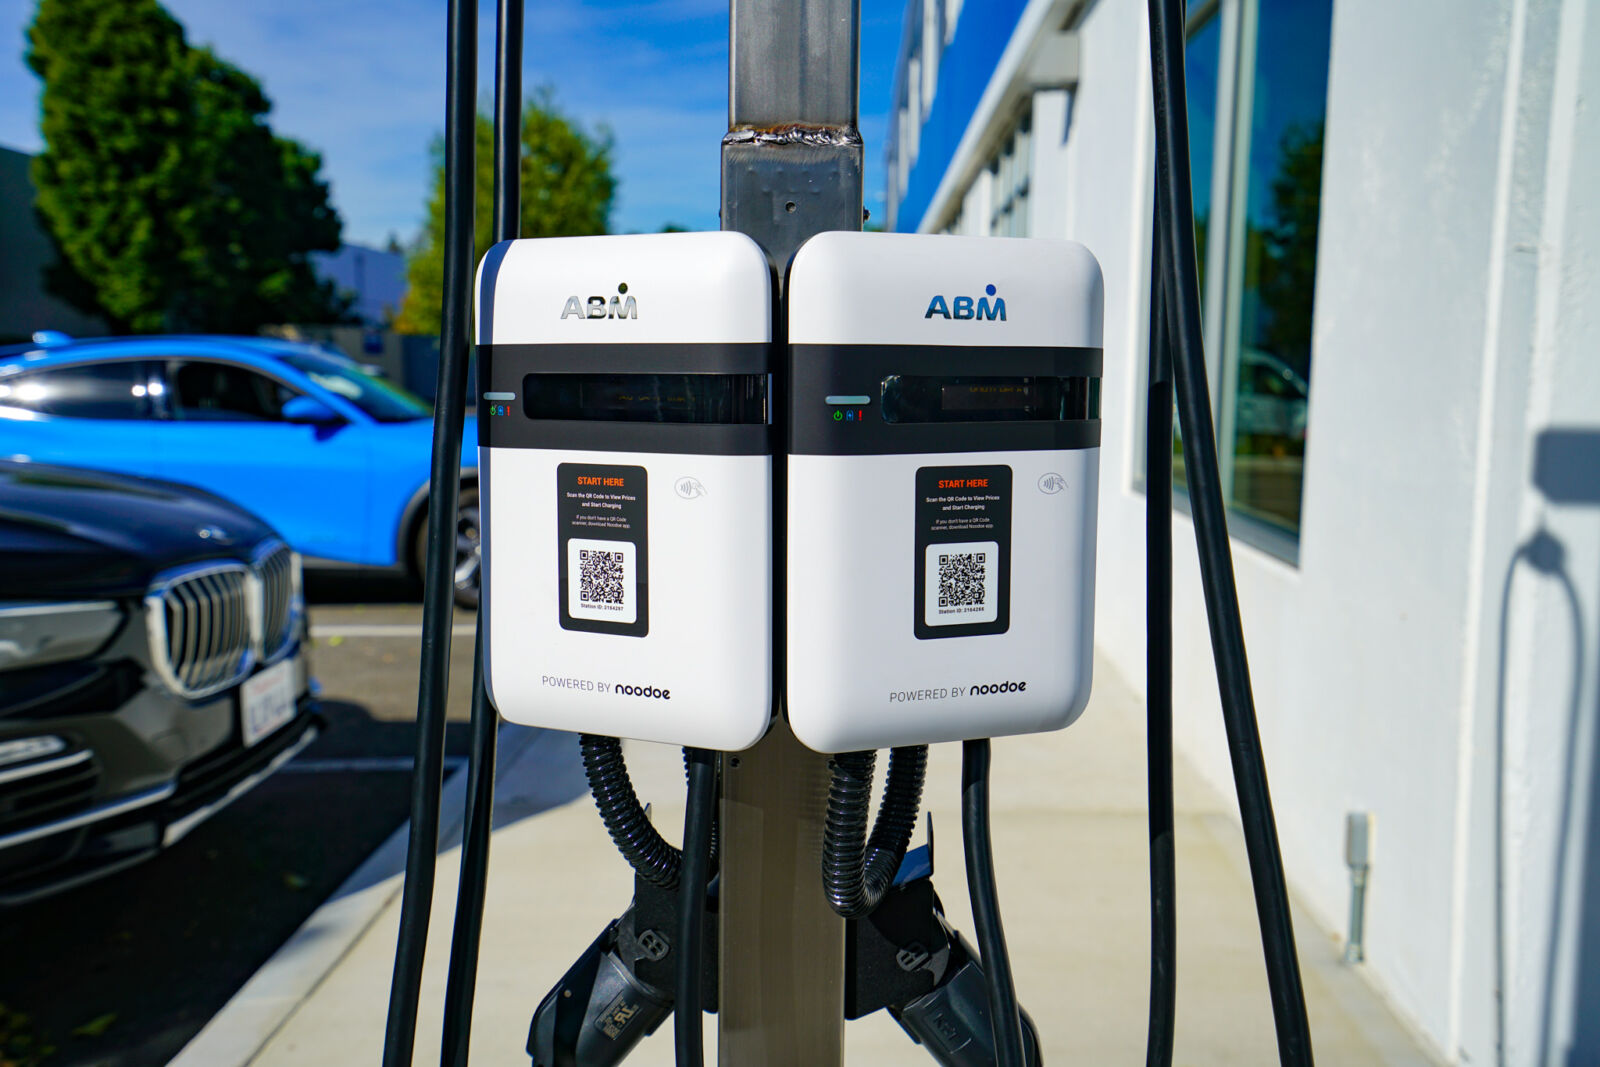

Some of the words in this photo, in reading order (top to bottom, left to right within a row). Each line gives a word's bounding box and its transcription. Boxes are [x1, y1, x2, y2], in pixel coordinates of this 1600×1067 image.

[560, 282, 638, 320] ABM
[924, 283, 1007, 321] ABM
[577, 476, 602, 486] START
[603, 477, 625, 487] HERE
[938, 479, 965, 489] START
[966, 478, 989, 488] HERE
[602, 502, 622, 510] Charging
[964, 503, 985, 511] Charging
[541, 675, 594, 692] POWERED
[597, 682, 611, 693] BY
[614, 683, 671, 701] noodoe
[889, 688, 948, 702] POWERED
[951, 686, 967, 698] BY
[969, 680, 1027, 696] noodoe
